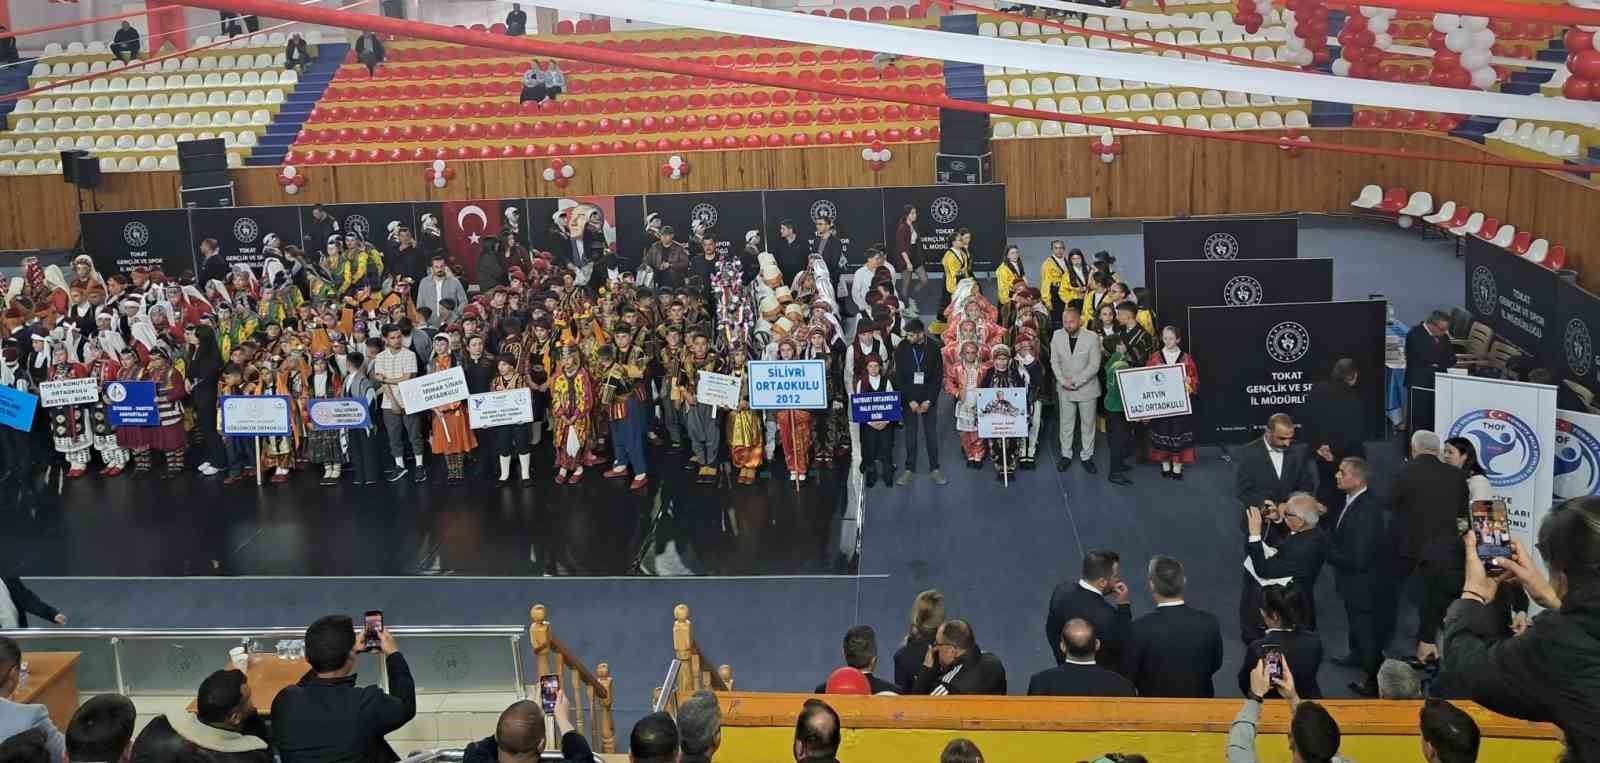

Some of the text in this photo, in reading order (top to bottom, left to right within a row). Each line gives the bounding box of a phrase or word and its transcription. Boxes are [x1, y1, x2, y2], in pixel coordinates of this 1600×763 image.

[767, 365, 805, 378] SİLİVRİ
[1272, 372, 1303, 380] TOKAT
[755, 381, 820, 391] ORTAOKULU
[1246, 384, 1287, 395] GENÇLİK
[1288, 383, 1301, 392] VE
[775, 394, 801, 404] 2012
[1142, 391, 1166, 401] ARTVİN
[1250, 395, 1259, 405] İL
[1145, 400, 1185, 412] ORTAOKULU
[1482, 421, 1507, 431] THOF
[1555, 435, 1571, 445] OF
